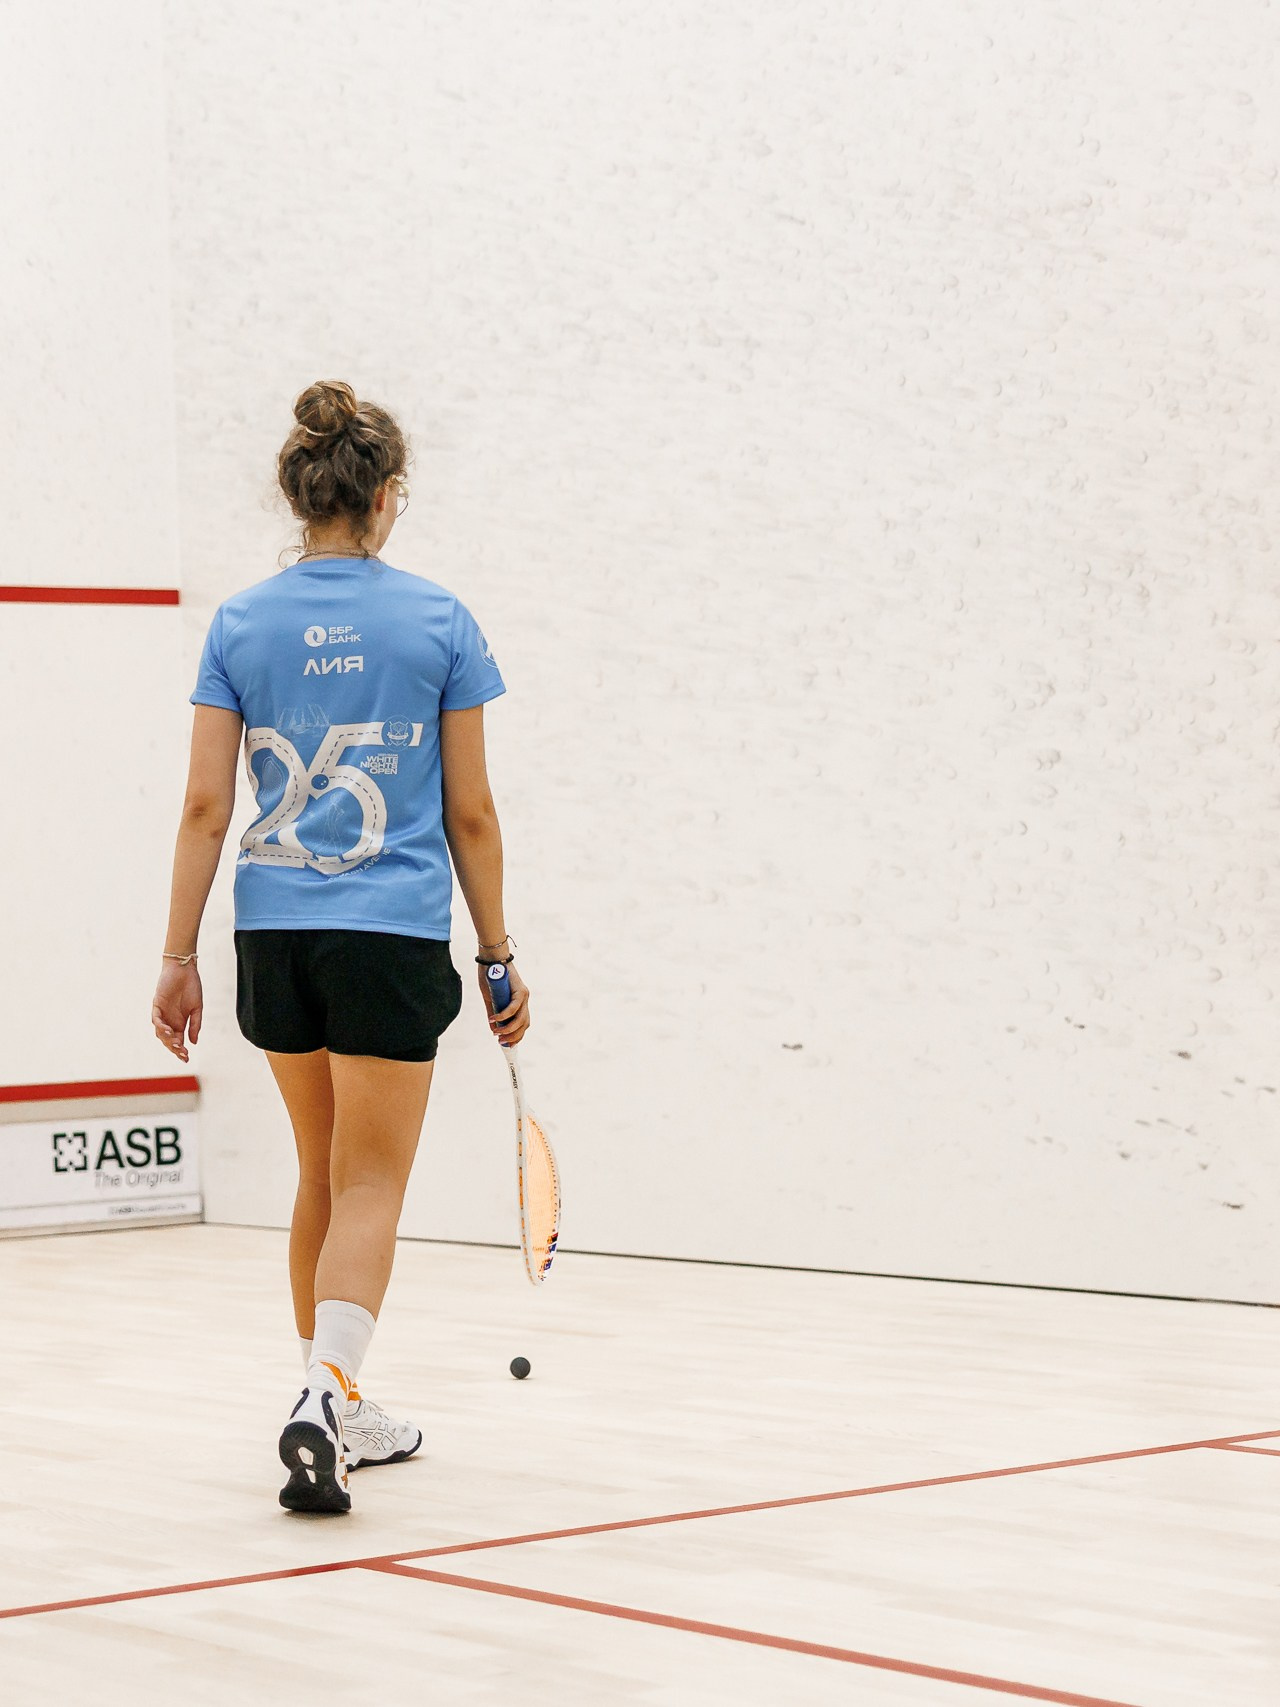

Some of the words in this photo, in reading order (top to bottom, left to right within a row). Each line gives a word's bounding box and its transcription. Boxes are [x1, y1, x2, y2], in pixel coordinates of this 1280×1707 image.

[328, 625, 354, 635] ББР
[328, 633, 362, 644] БАНК
[303, 655, 364, 676] ЛИЯ
[360, 761, 399, 769] NIGHTS
[366, 755, 399, 763] WHITE
[239, 722, 424, 875] 25
[95, 1127, 182, 1170] ASB
[96, 1170, 122, 1188] The
[125, 1169, 182, 1188] Original
